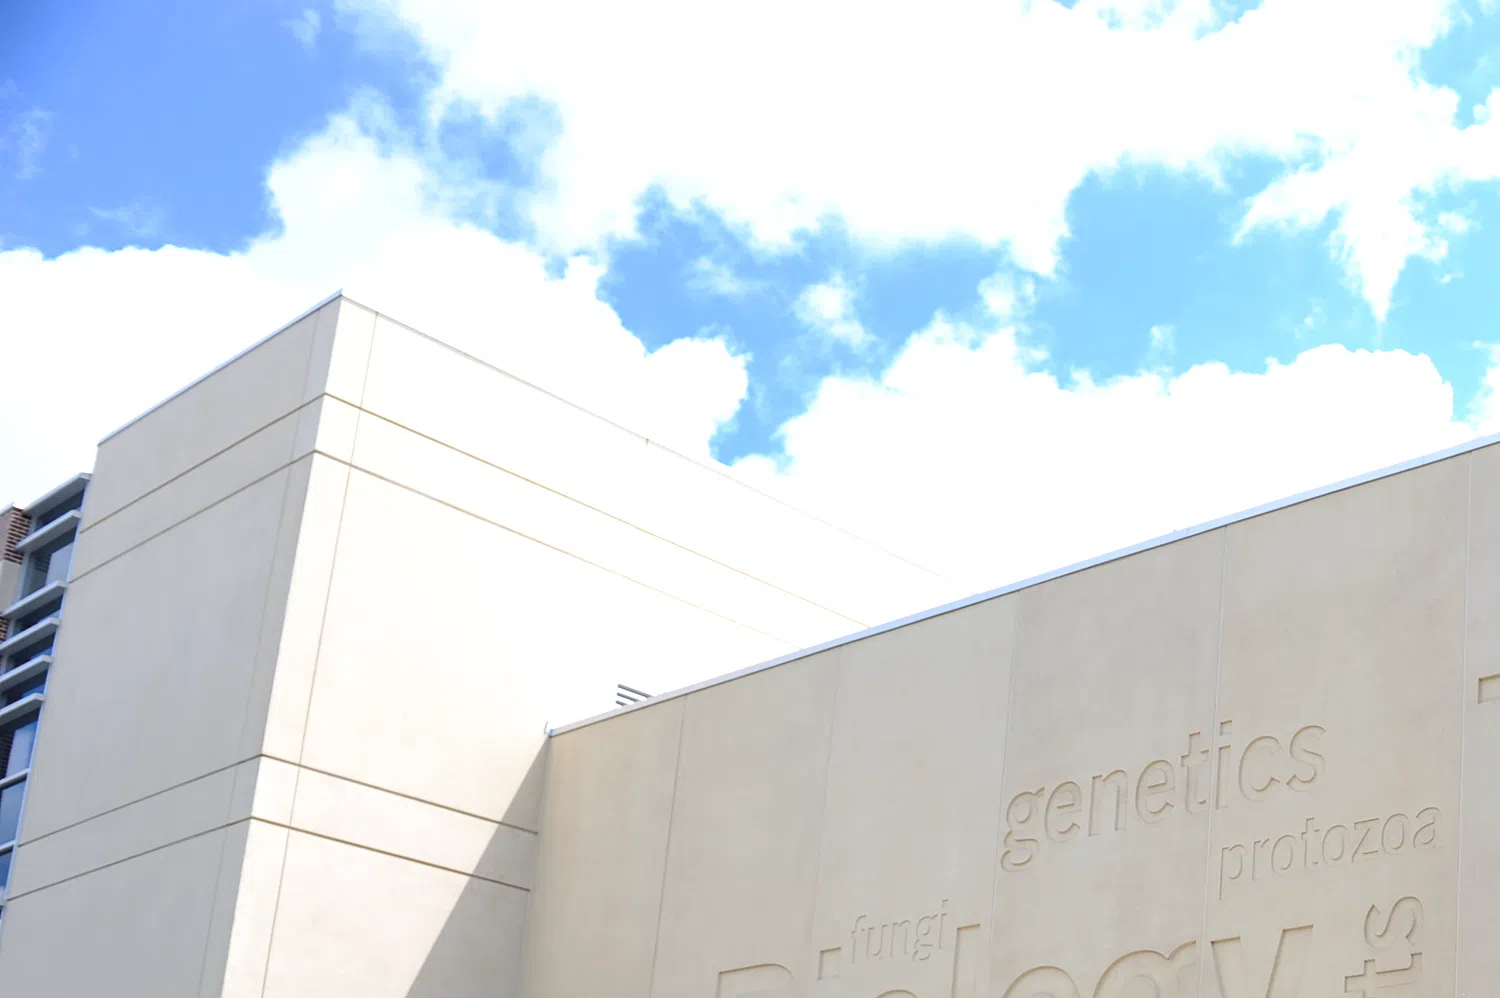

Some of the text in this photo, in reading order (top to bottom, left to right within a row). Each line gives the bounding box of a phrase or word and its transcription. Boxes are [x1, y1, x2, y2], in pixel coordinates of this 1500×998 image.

[1000, 719, 1328, 873] genetics
[1219, 806, 1442, 900] protozoa
[849, 899, 950, 963] fungi
